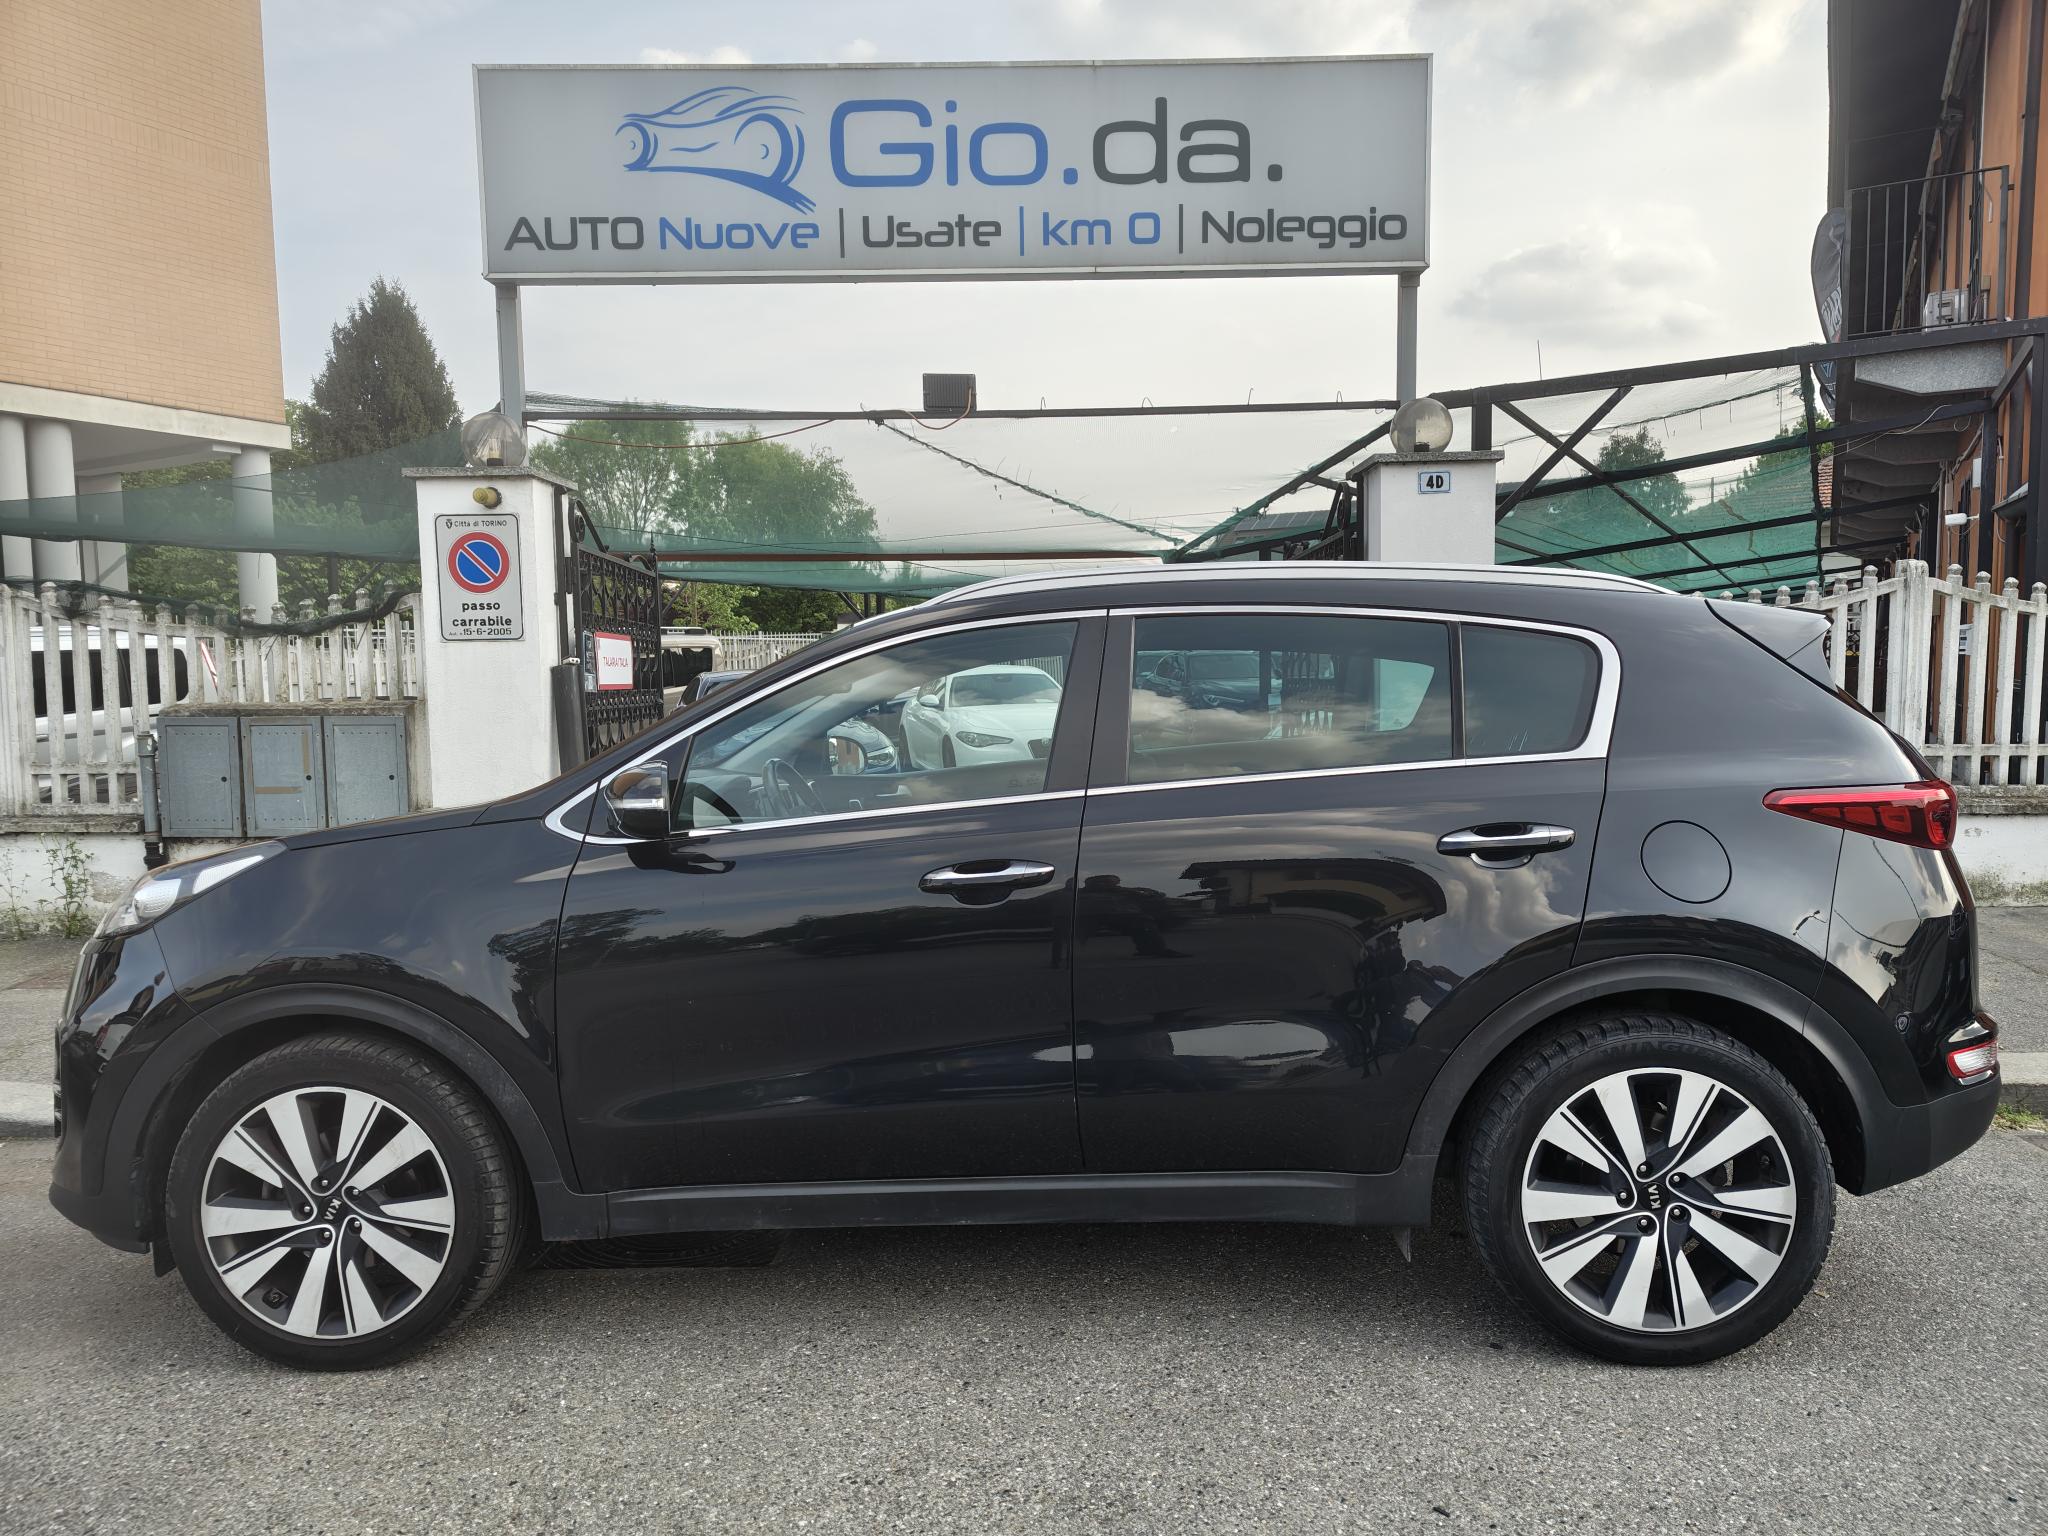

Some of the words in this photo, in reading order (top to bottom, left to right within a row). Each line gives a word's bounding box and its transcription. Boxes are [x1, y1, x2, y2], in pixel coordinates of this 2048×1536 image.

[830, 96, 1283, 188] Gio.da.
[503, 217, 645, 252] AUTO
[659, 216, 820, 251] Nuove
[862, 214, 1002, 249] Usate
[1042, 211, 1112, 246] km
[1201, 208, 1408, 250] Noleggio
[1426, 475, 1443, 488] 4D
[462, 602, 500, 612] passo
[452, 615, 512, 626] carrabile
[1648, 1184, 1661, 1209] KIA
[324, 1199, 342, 1220] KIA
